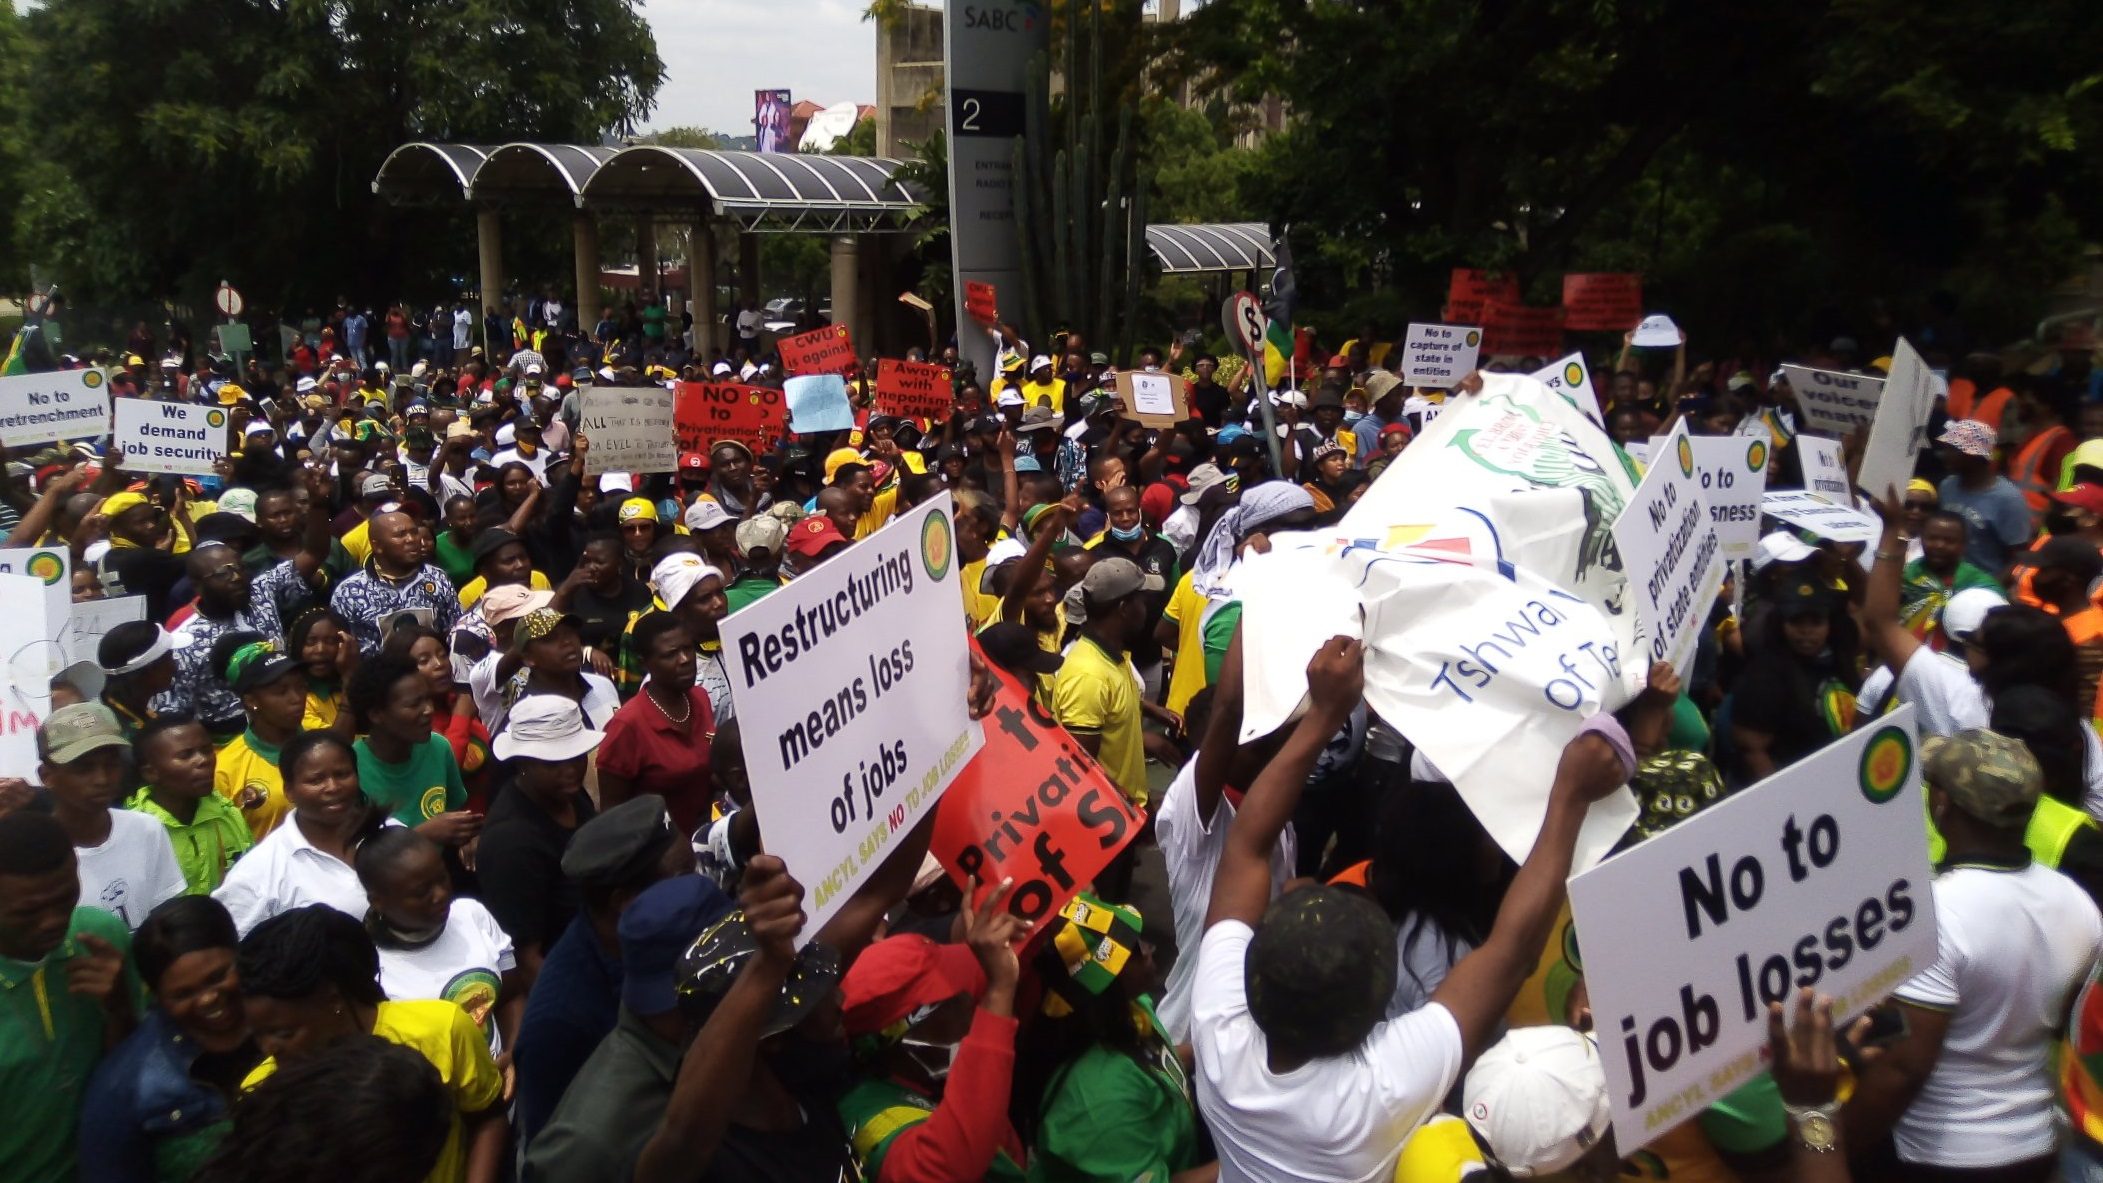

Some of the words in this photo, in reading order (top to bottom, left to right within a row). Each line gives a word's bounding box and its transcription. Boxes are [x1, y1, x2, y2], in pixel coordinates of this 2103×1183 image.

[964, 6, 1018, 32] SABC
[962, 98, 980, 131] 2
[975, 161, 1012, 171] ENTRA
[795, 329, 833, 348] CWU
[1425, 328, 1439, 338] No
[1441, 329, 1452, 338] to
[787, 356, 798, 367] is
[802, 341, 850, 364] against
[1410, 342, 1449, 352] capture
[1451, 343, 1463, 352] of
[1415, 354, 1441, 364] state
[1443, 355, 1453, 364] in
[894, 362, 939, 380] Away
[1413, 367, 1451, 376] entities
[899, 377, 932, 390] with
[1813, 372, 1860, 390] Our
[28, 392, 49, 406] No
[54, 391, 70, 402] to
[703, 386, 739, 404] NO
[763, 391, 779, 405] O
[878, 391, 950, 406] nepotism
[0, 406, 104, 428] retrenchment
[162, 405, 187, 420] We
[710, 406, 731, 421] to
[882, 402, 896, 414] in
[903, 405, 942, 418] SABC
[1426, 410, 1438, 422] A
[140, 423, 206, 441] demand
[583, 416, 607, 432] ALL
[678, 422, 759, 437] Privatisation
[121, 442, 148, 456] job
[154, 443, 221, 462] security
[606, 439, 631, 450] EVIL
[679, 435, 700, 450] of
[1698, 467, 1711, 489] o
[1717, 466, 1734, 489] to
[1649, 499, 1667, 534] No
[1663, 480, 1677, 509] to
[1648, 499, 1701, 611] privatization
[1654, 621, 1668, 660] of
[1666, 585, 1691, 639] state
[1689, 527, 1719, 594] entities
[738, 548, 914, 689] Restructuring
[1544, 653, 1596, 711] of
[778, 677, 867, 771] means
[869, 639, 914, 699] loss
[831, 772, 856, 834] of
[859, 739, 907, 821] jobs
[955, 743, 1091, 888] Privati
[814, 855, 858, 909] ANCYL
[858, 821, 888, 865] SAYS
[888, 803, 905, 834] NO
[905, 787, 920, 813] TO
[921, 766, 940, 800] JOB
[1008, 831, 1075, 921] of
[1077, 788, 1130, 850] S
[1678, 853, 1764, 942] No
[1781, 813, 1840, 883] to
[1620, 984, 1721, 1109] job
[1735, 878, 1916, 1023] losses
